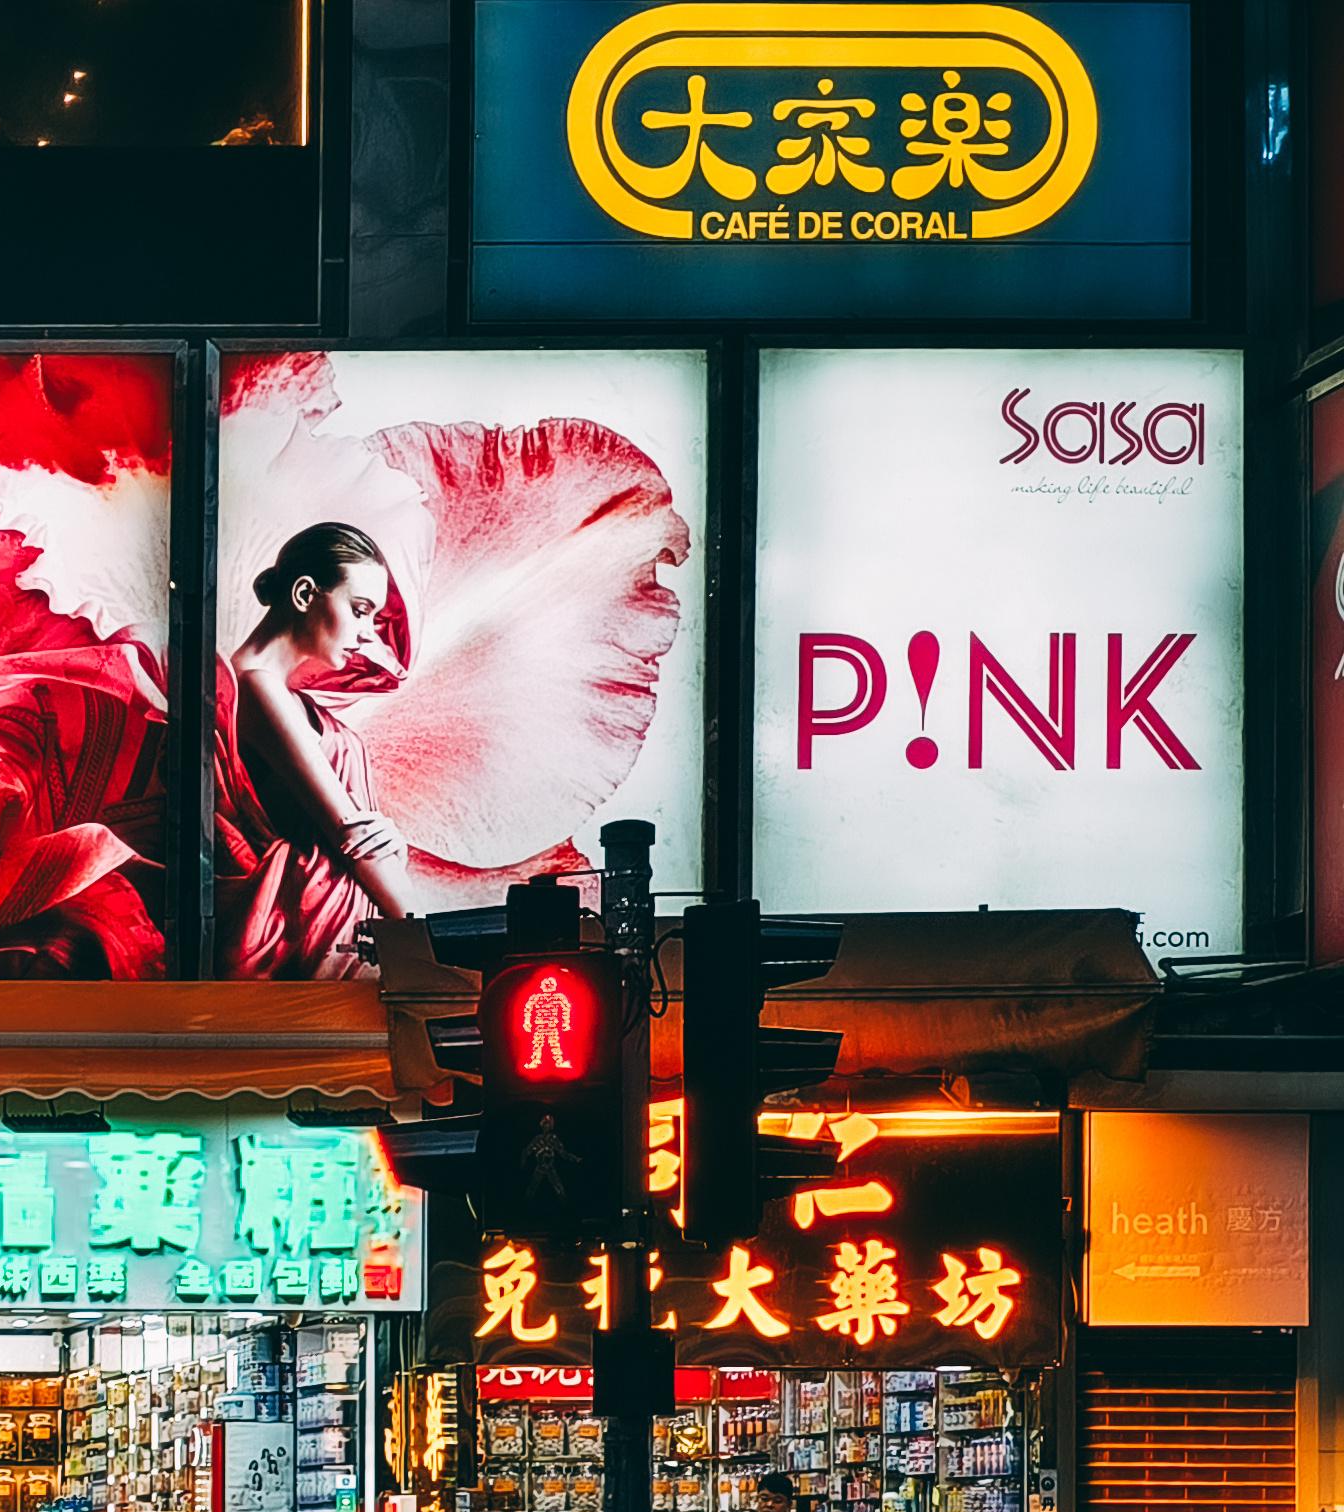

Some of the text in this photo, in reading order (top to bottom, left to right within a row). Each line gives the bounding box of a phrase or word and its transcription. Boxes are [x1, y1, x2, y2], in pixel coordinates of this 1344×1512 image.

[700, 205, 968, 240] CAFÉ DE CORAL
[999, 387, 1206, 466] Sasa
[797, 630, 1203, 771] P!NK
[1111, 1201, 1283, 1235] heath 慶方
